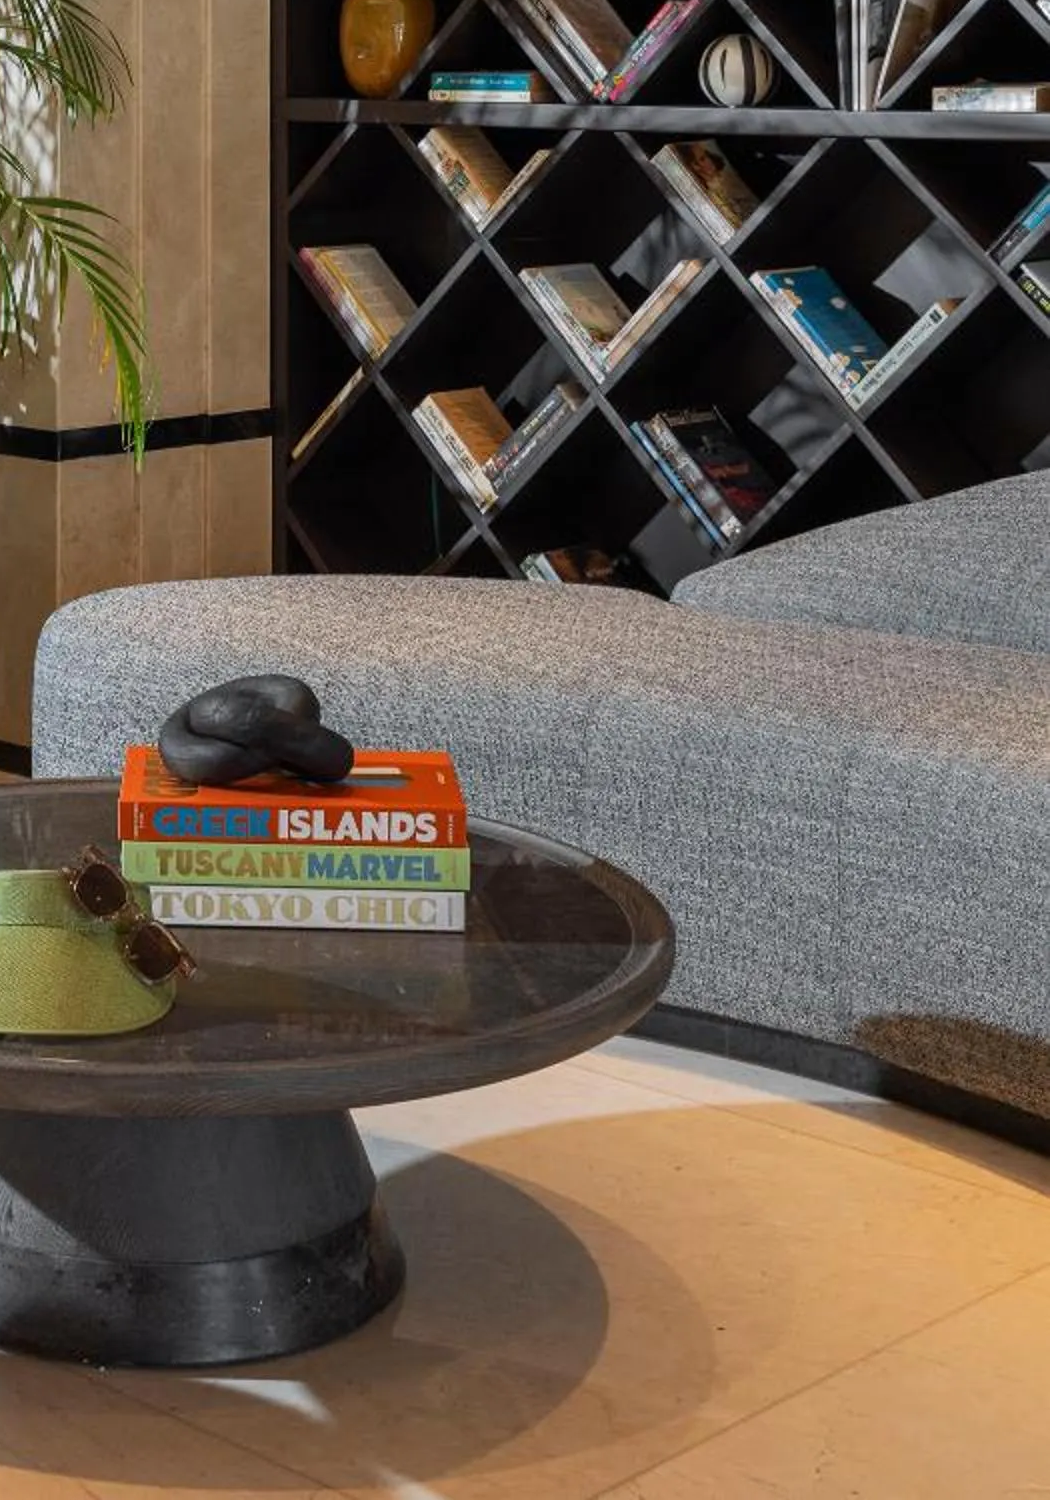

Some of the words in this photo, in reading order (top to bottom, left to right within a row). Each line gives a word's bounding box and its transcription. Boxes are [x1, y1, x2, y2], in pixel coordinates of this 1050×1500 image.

[153, 807, 271, 838] GREEK
[278, 809, 438, 843] ISLANDS
[156, 849, 305, 879] TUSCANY
[307, 854, 442, 882] MARVEL
[153, 891, 313, 922] TOKYO
[325, 895, 438, 927] CHIC
